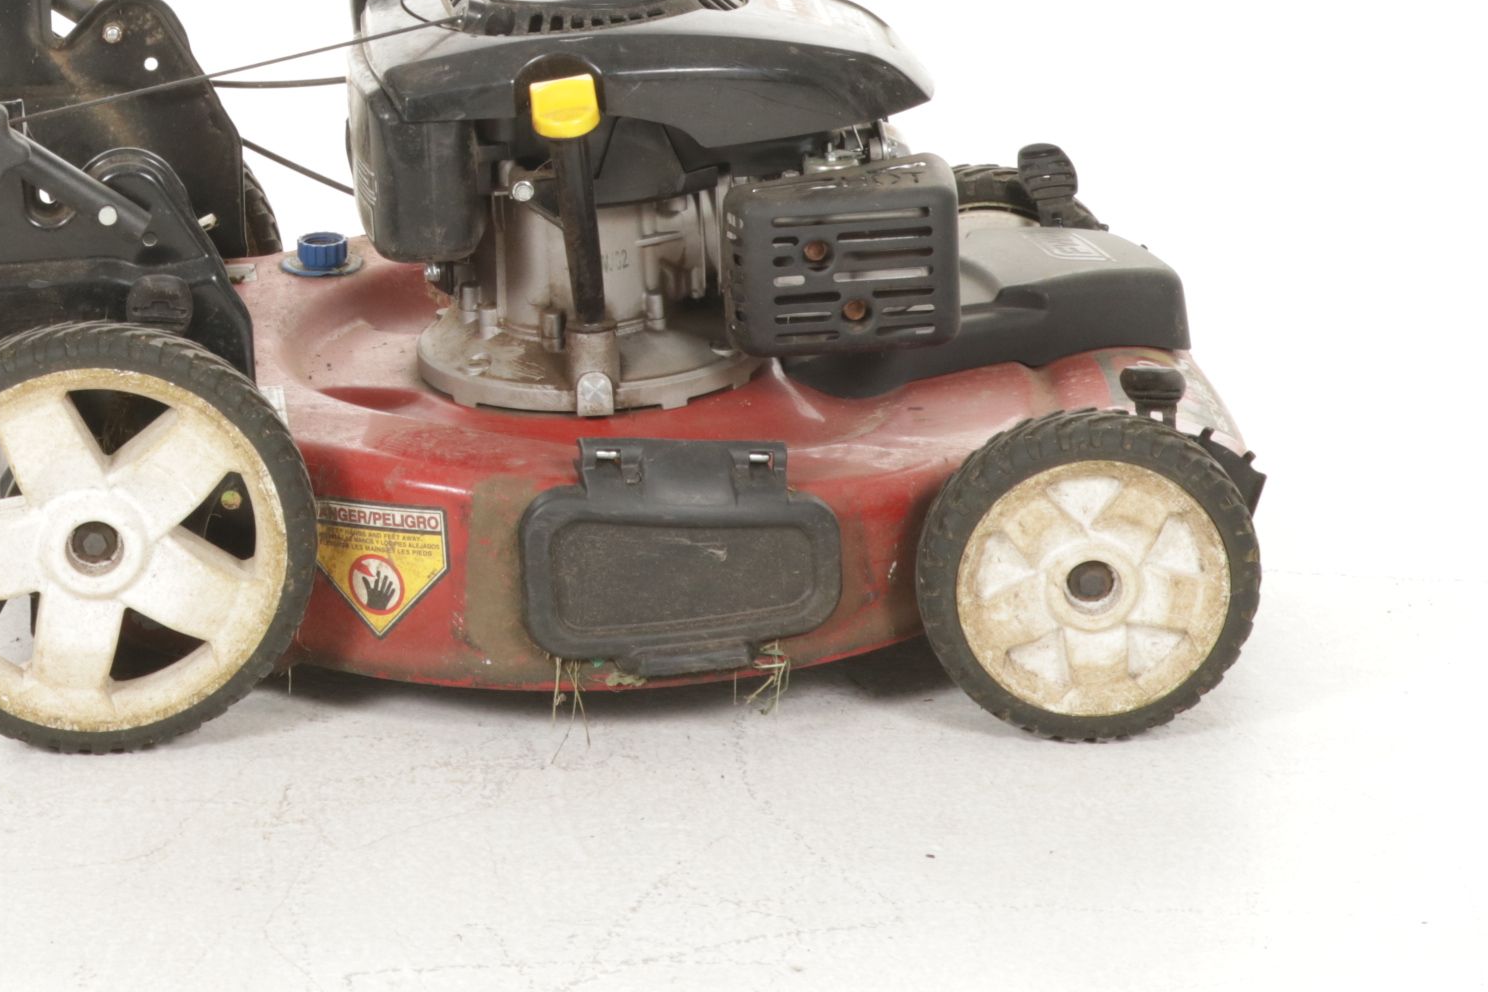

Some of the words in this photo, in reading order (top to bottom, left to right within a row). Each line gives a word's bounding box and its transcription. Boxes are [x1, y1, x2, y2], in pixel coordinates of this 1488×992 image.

[368, 532, 382, 540] AND
[383, 533, 400, 541] FEET
[412, 549, 432, 557] PIEDS
